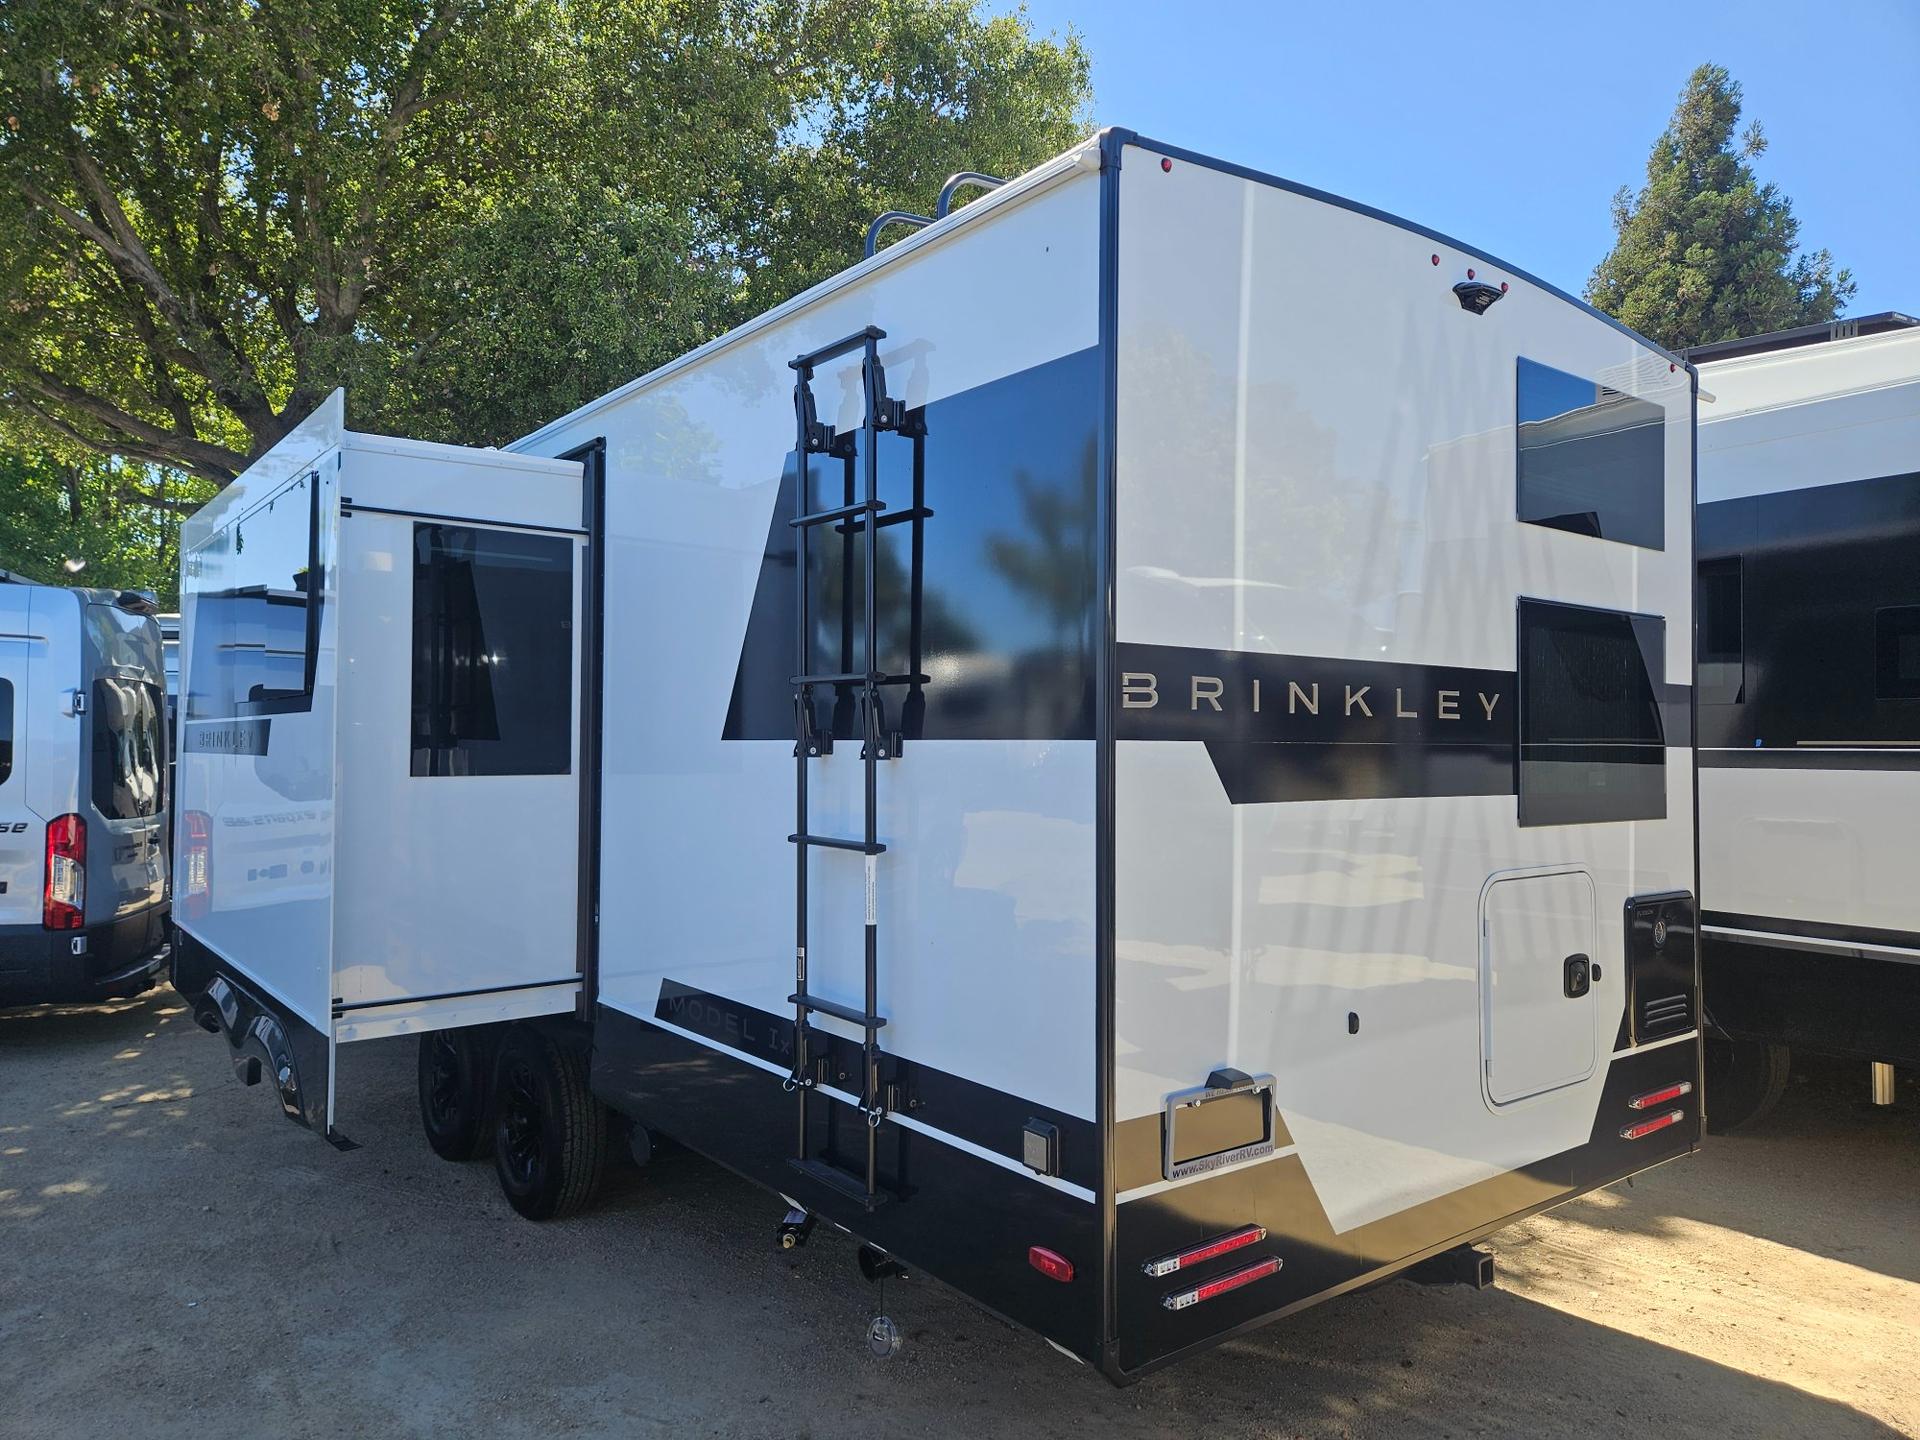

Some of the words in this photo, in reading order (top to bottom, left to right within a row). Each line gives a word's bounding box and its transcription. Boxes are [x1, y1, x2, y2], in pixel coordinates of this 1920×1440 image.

[1121, 671, 1500, 721] BRINKLEY
[199, 728, 256, 752] BRINKLEY
[669, 996, 756, 1042] MODEL
[1172, 1143, 1273, 1179] www.SkyRiverRV.com
